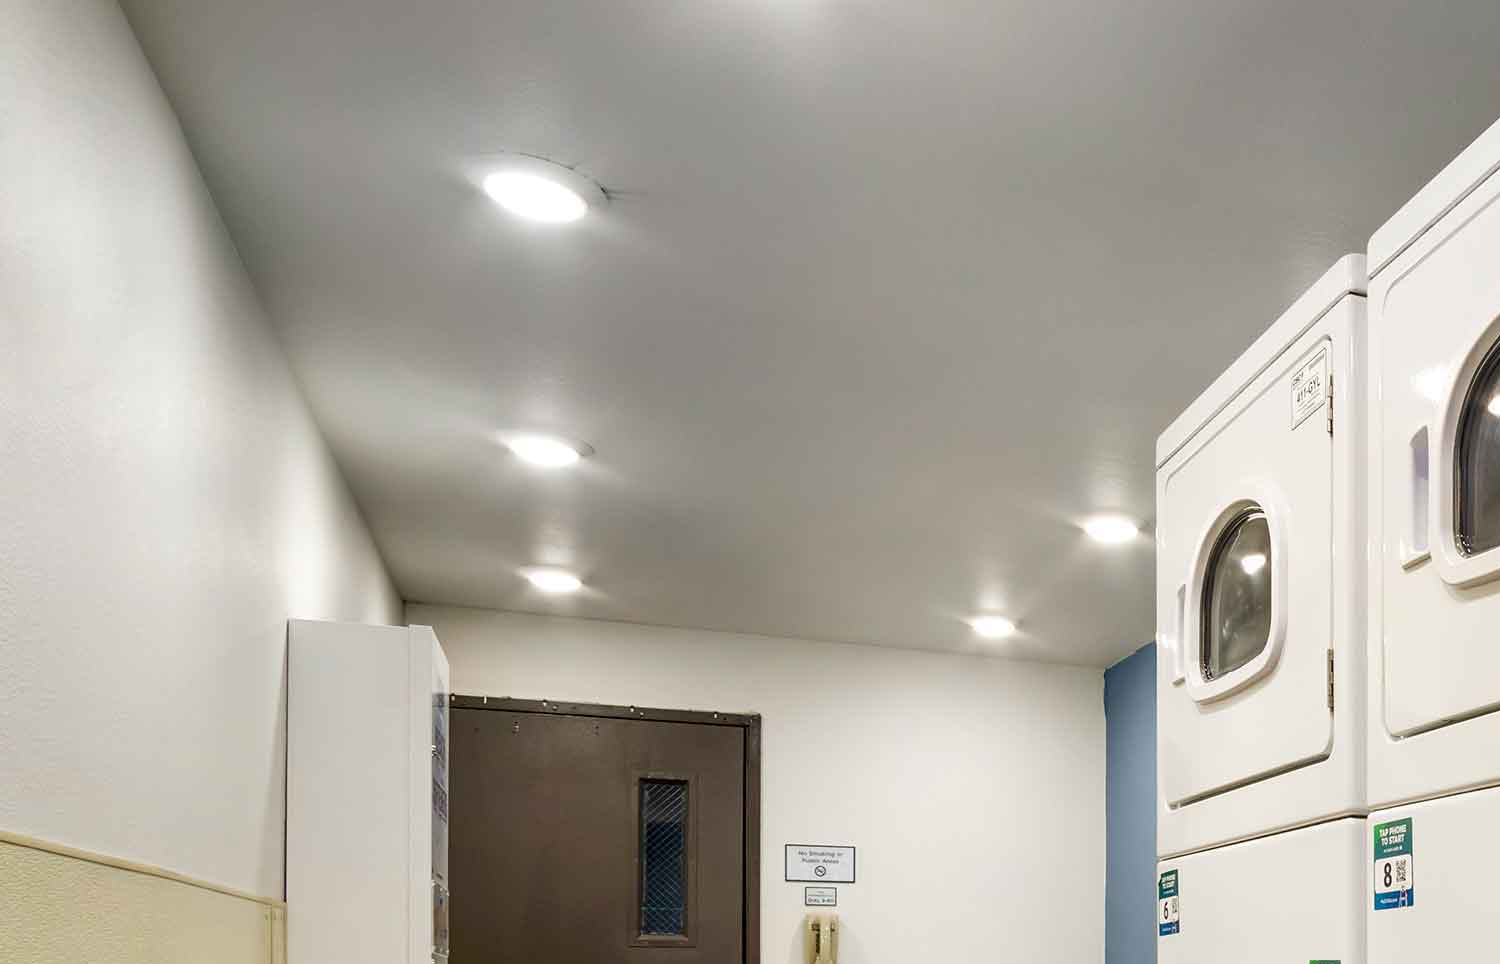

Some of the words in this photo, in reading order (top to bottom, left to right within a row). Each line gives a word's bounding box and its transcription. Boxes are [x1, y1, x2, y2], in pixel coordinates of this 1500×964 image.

[1389, 824, 1406, 836] PHONE
[1382, 838, 1388, 846] TO
[1389, 834, 1404, 845] START
[1384, 862, 1392, 887] 8
